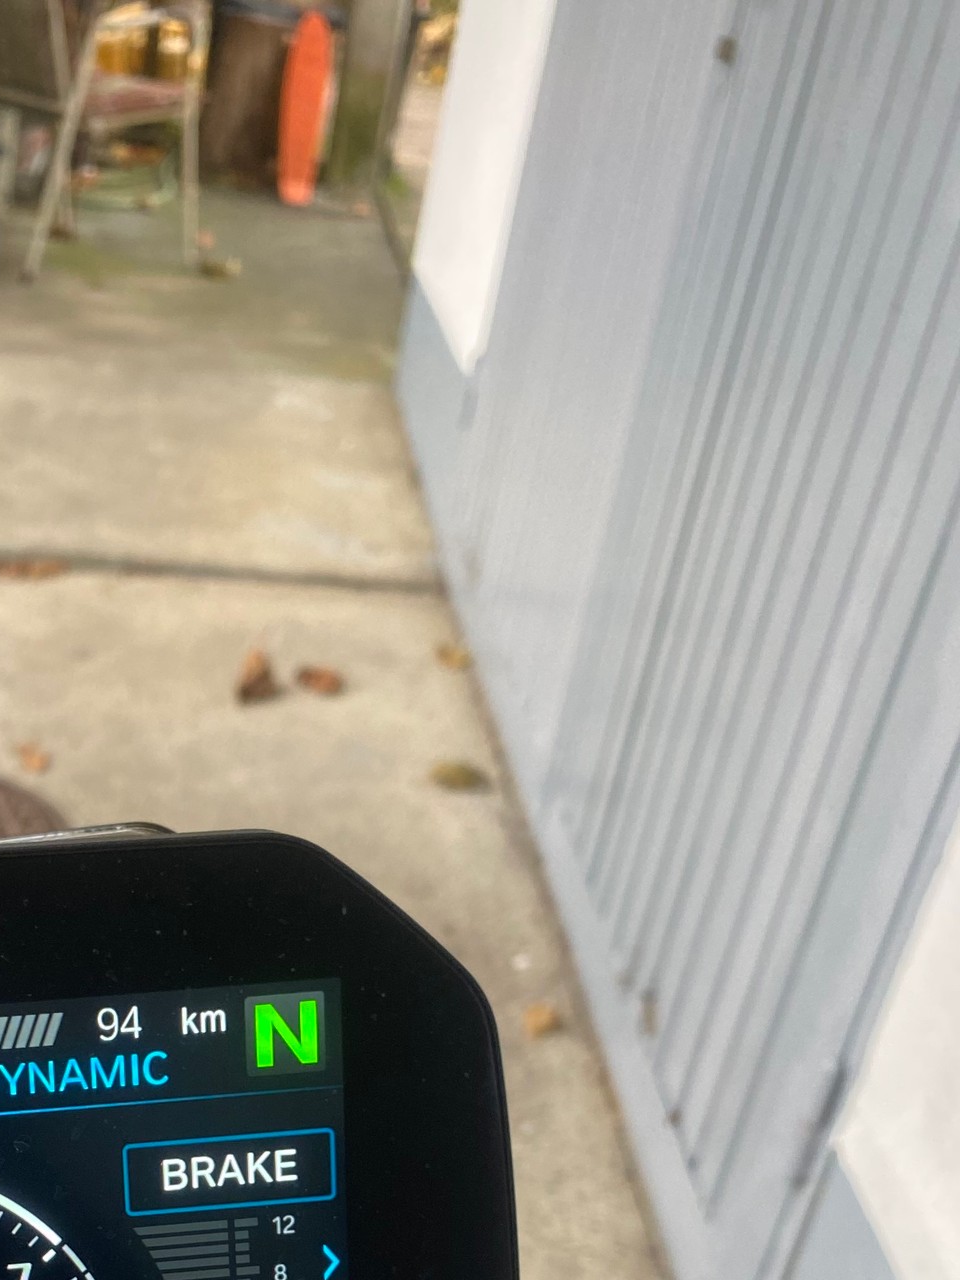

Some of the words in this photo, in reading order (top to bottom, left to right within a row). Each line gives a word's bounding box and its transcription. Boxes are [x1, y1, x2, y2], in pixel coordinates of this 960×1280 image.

[96, 1005, 143, 1042] 94
[181, 1006, 227, 1036] km
[254, 999, 318, 1068] N
[160, 1148, 299, 1192] BRAKE
[272, 1214, 296, 1235] 12
